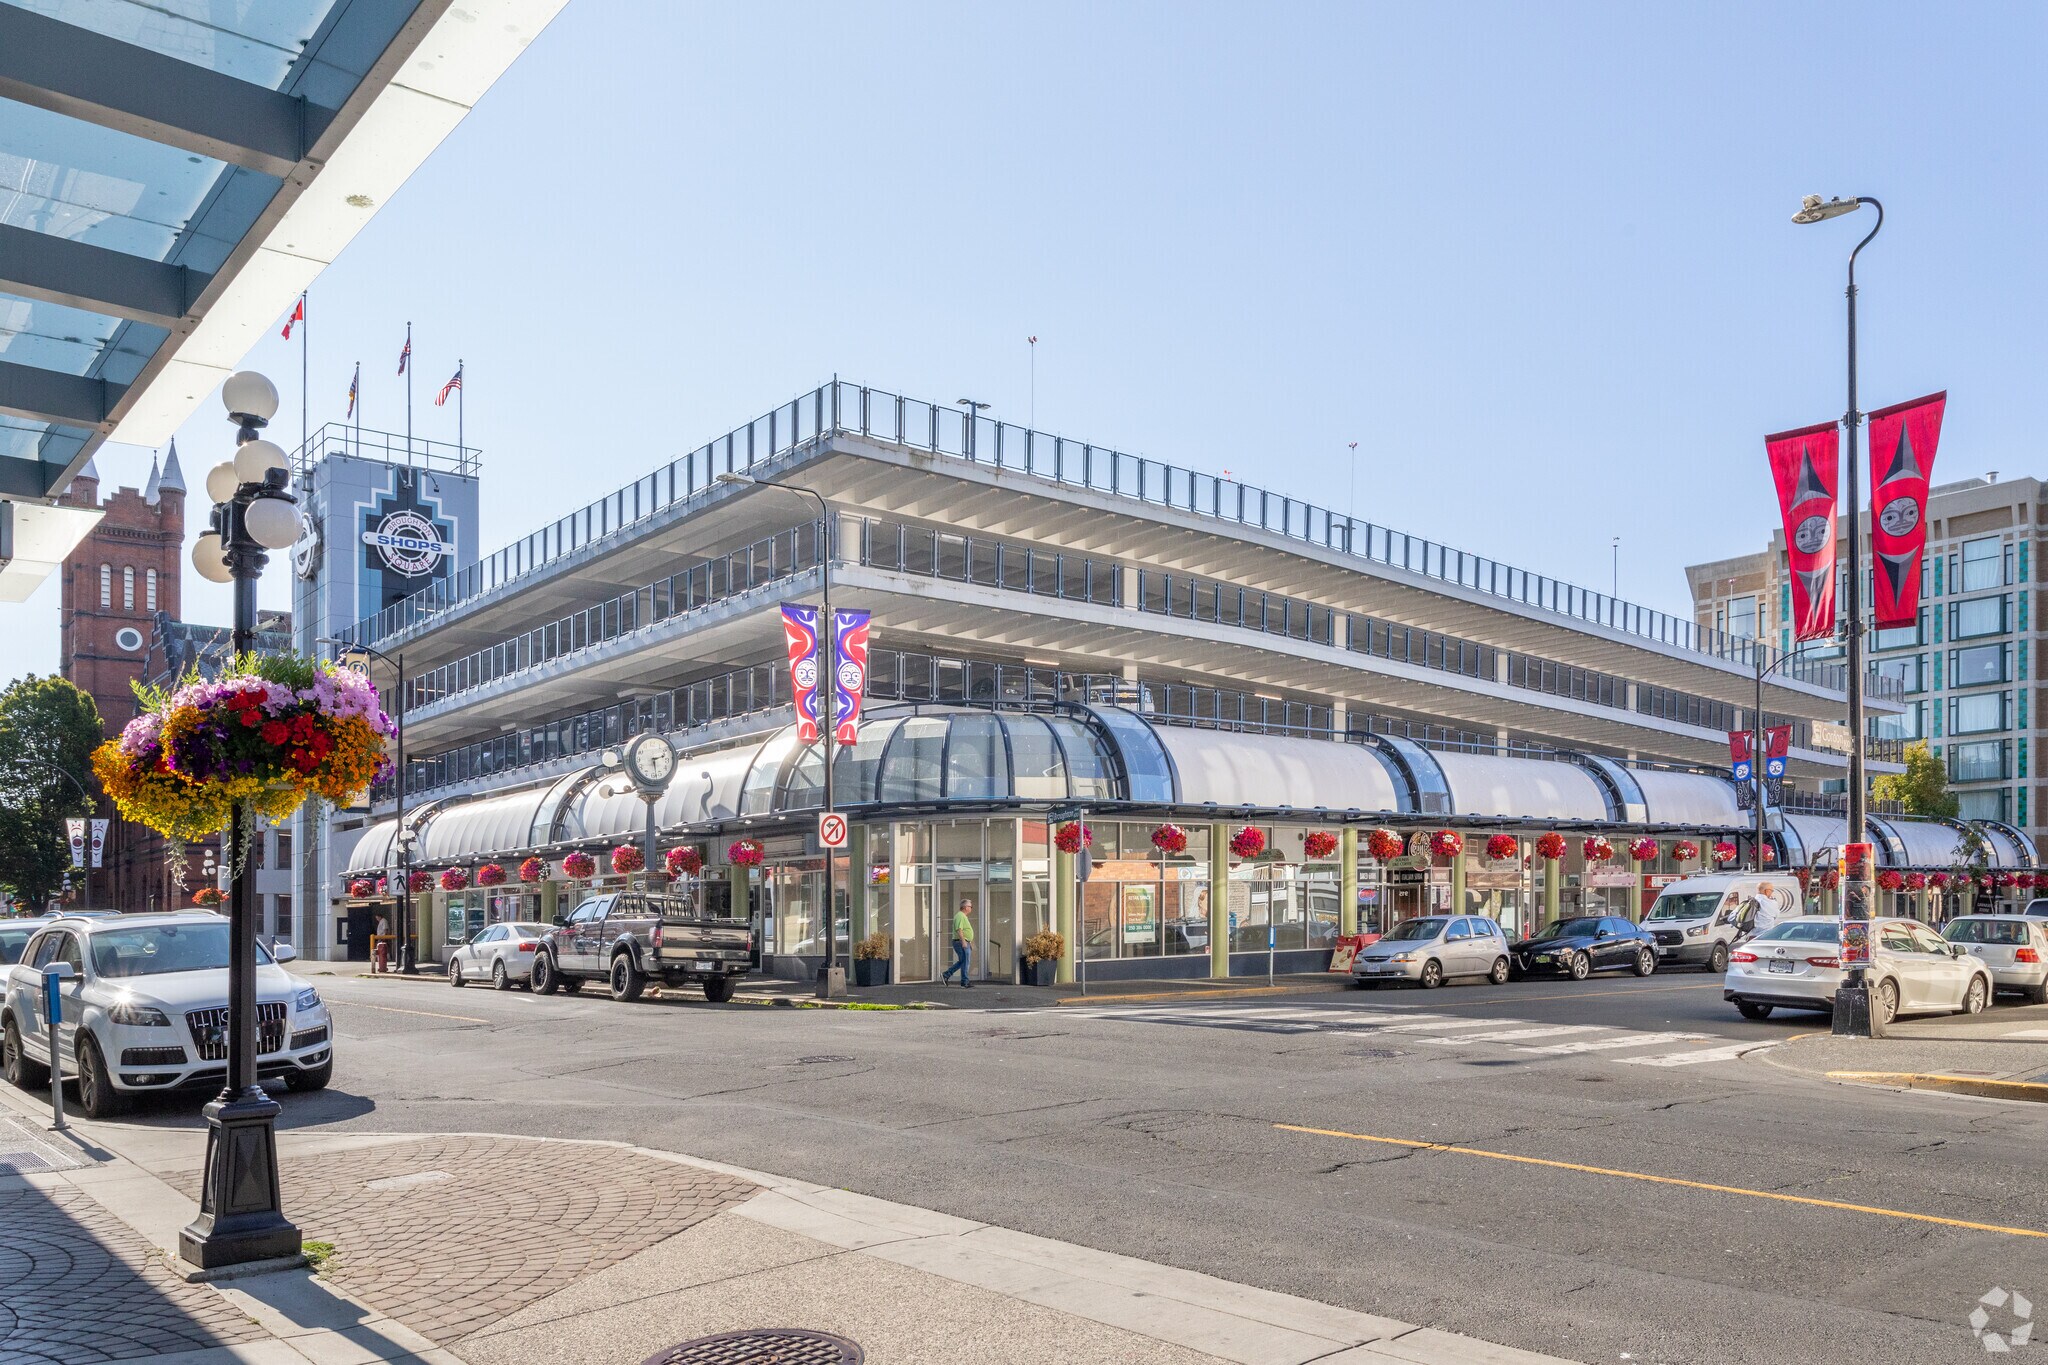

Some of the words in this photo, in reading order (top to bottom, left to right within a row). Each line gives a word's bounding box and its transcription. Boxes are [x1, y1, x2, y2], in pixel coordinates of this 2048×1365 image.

[388, 517, 432, 537] BROUGHTON
[377, 535, 442, 552] SHOPS
[388, 552, 432, 571] SQUARE
